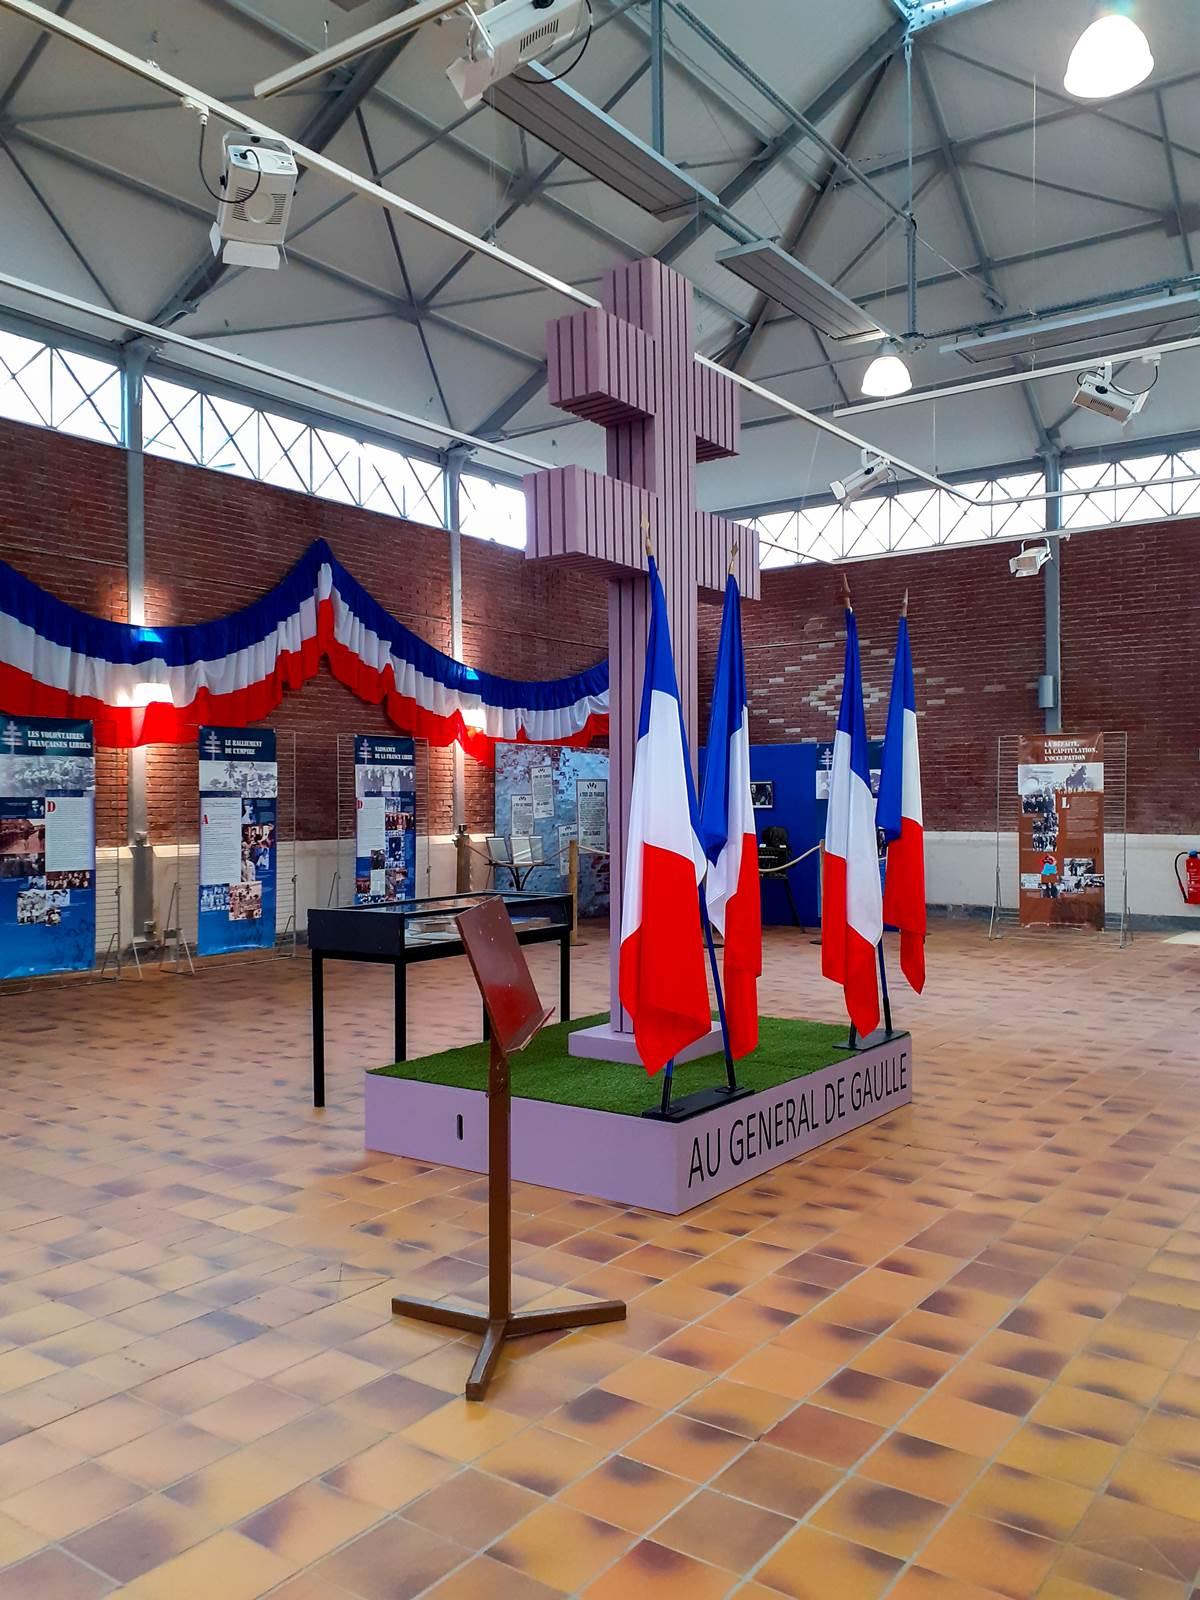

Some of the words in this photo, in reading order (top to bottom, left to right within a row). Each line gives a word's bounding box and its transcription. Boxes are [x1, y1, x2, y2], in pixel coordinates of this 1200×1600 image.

[688, 1128, 721, 1188] AU
[729, 1089, 818, 1166] GENERAL
[824, 1077, 846, 1125] DE
[850, 1053, 908, 1111] GAULLE
